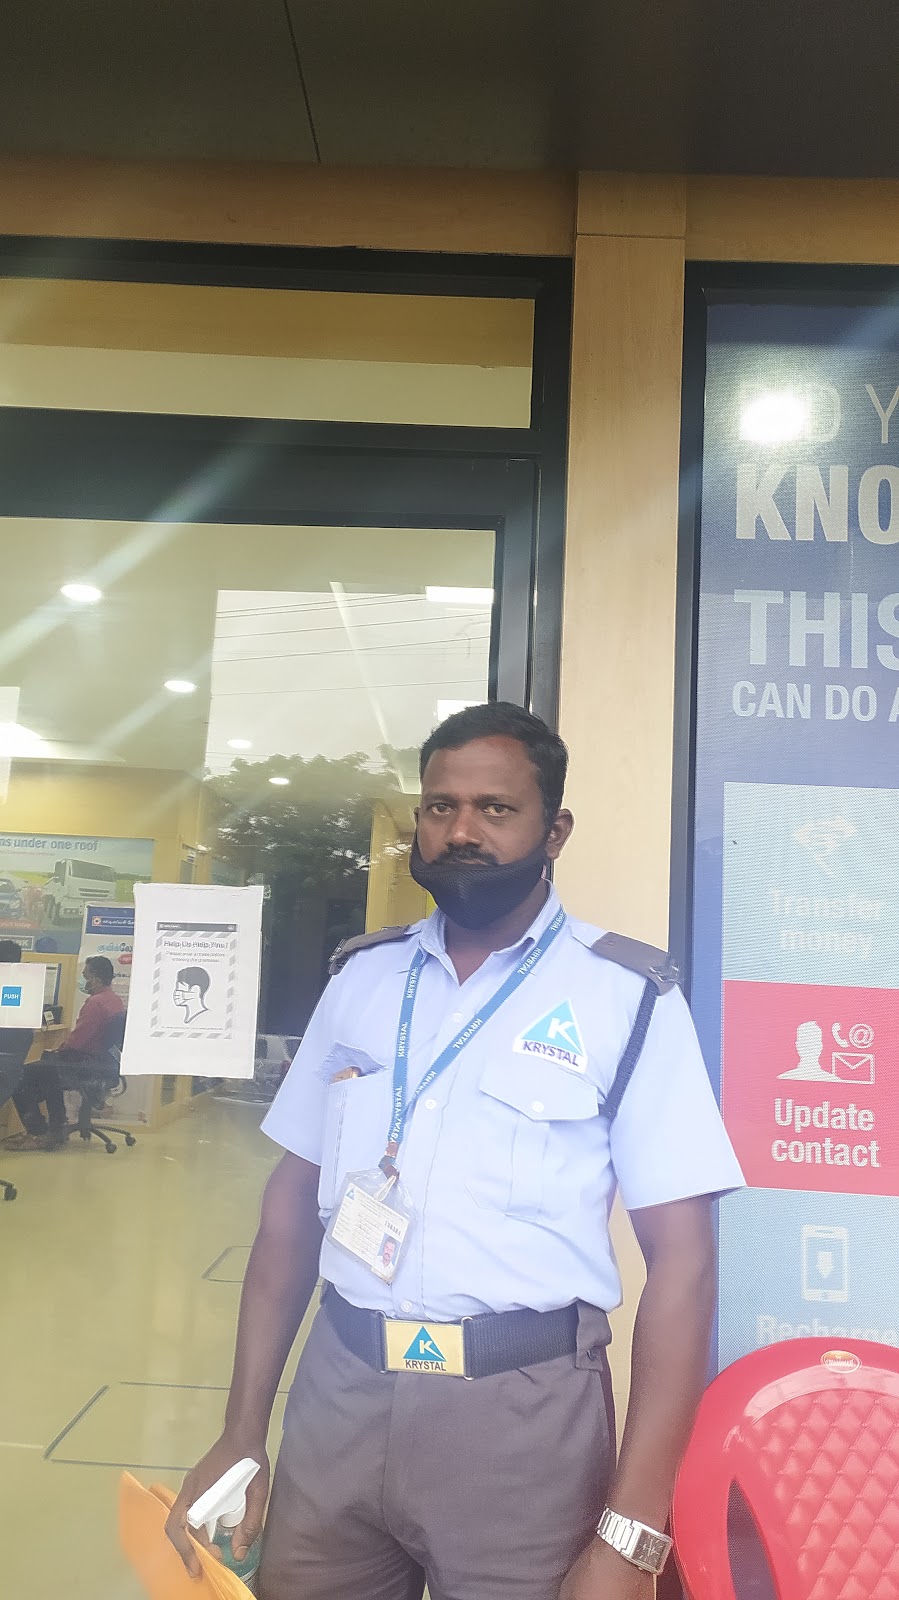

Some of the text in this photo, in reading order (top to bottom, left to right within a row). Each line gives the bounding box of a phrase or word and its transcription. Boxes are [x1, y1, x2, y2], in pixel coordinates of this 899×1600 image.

[731, 681, 812, 721] CAN
[825, 684, 877, 723] DO
[14, 838, 47, 849] under
[50, 840, 72, 850] one
[74, 840, 98, 851] roof
[769, 888, 885, 920] Transfer
[780, 929, 873, 960] money
[517, 947, 542, 975] KRYSTAL
[398, 1021, 408, 1057] KRYSTAL
[453, 1018, 482, 1049] KRYSTAL
[523, 1040, 579, 1067] KRYSTAL
[774, 1097, 875, 1133] Update
[771, 1137, 881, 1168] contact
[405, 1360, 447, 1371] KRYSTAL
